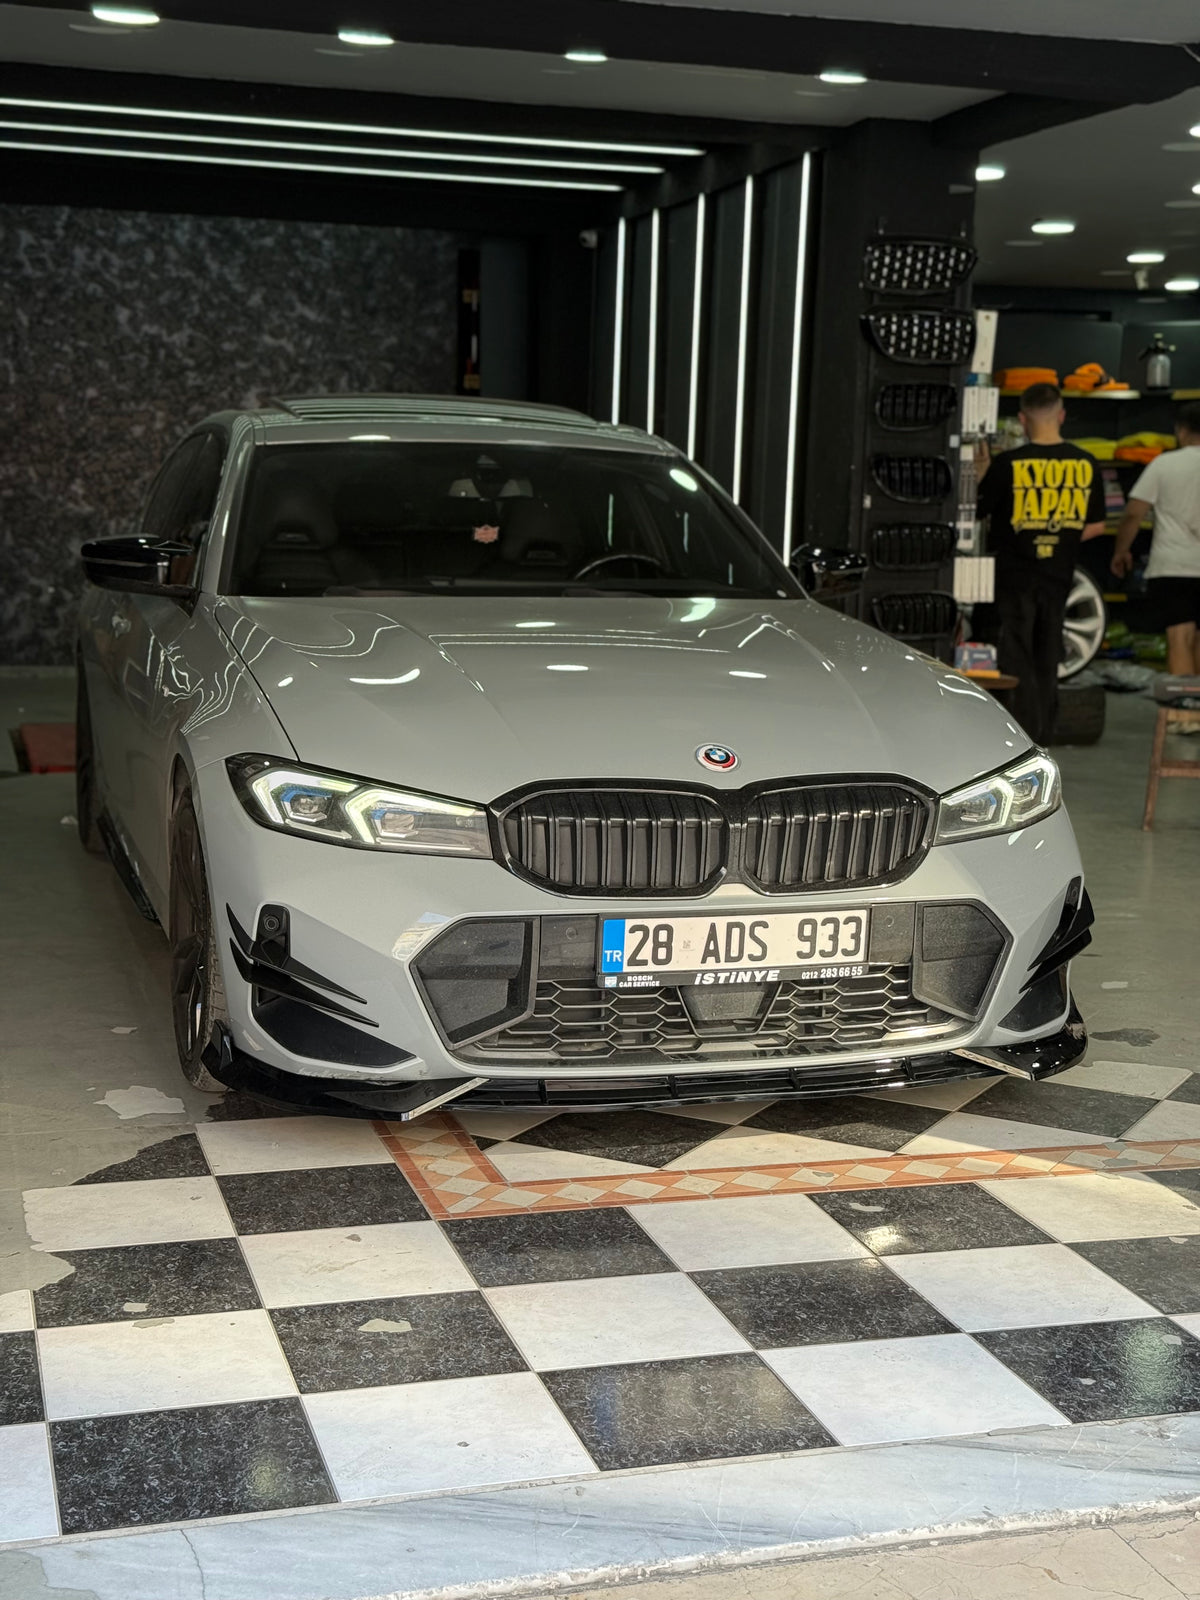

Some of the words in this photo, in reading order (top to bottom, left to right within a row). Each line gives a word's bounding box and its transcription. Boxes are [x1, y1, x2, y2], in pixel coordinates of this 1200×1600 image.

[1012, 458, 1093, 488] KYOTO
[1010, 488, 1091, 523] JAPAN
[626, 923, 674, 967] 28
[700, 921, 769, 964] ADS
[796, 915, 863, 960] 933
[604, 950, 622, 963] TR
[801, 970, 819, 980] 0212
[820, 967, 838, 979] 283
[838, 966, 851, 978] 66
[851, 965, 863, 976] 55
[632, 980, 660, 988] SERVICE
